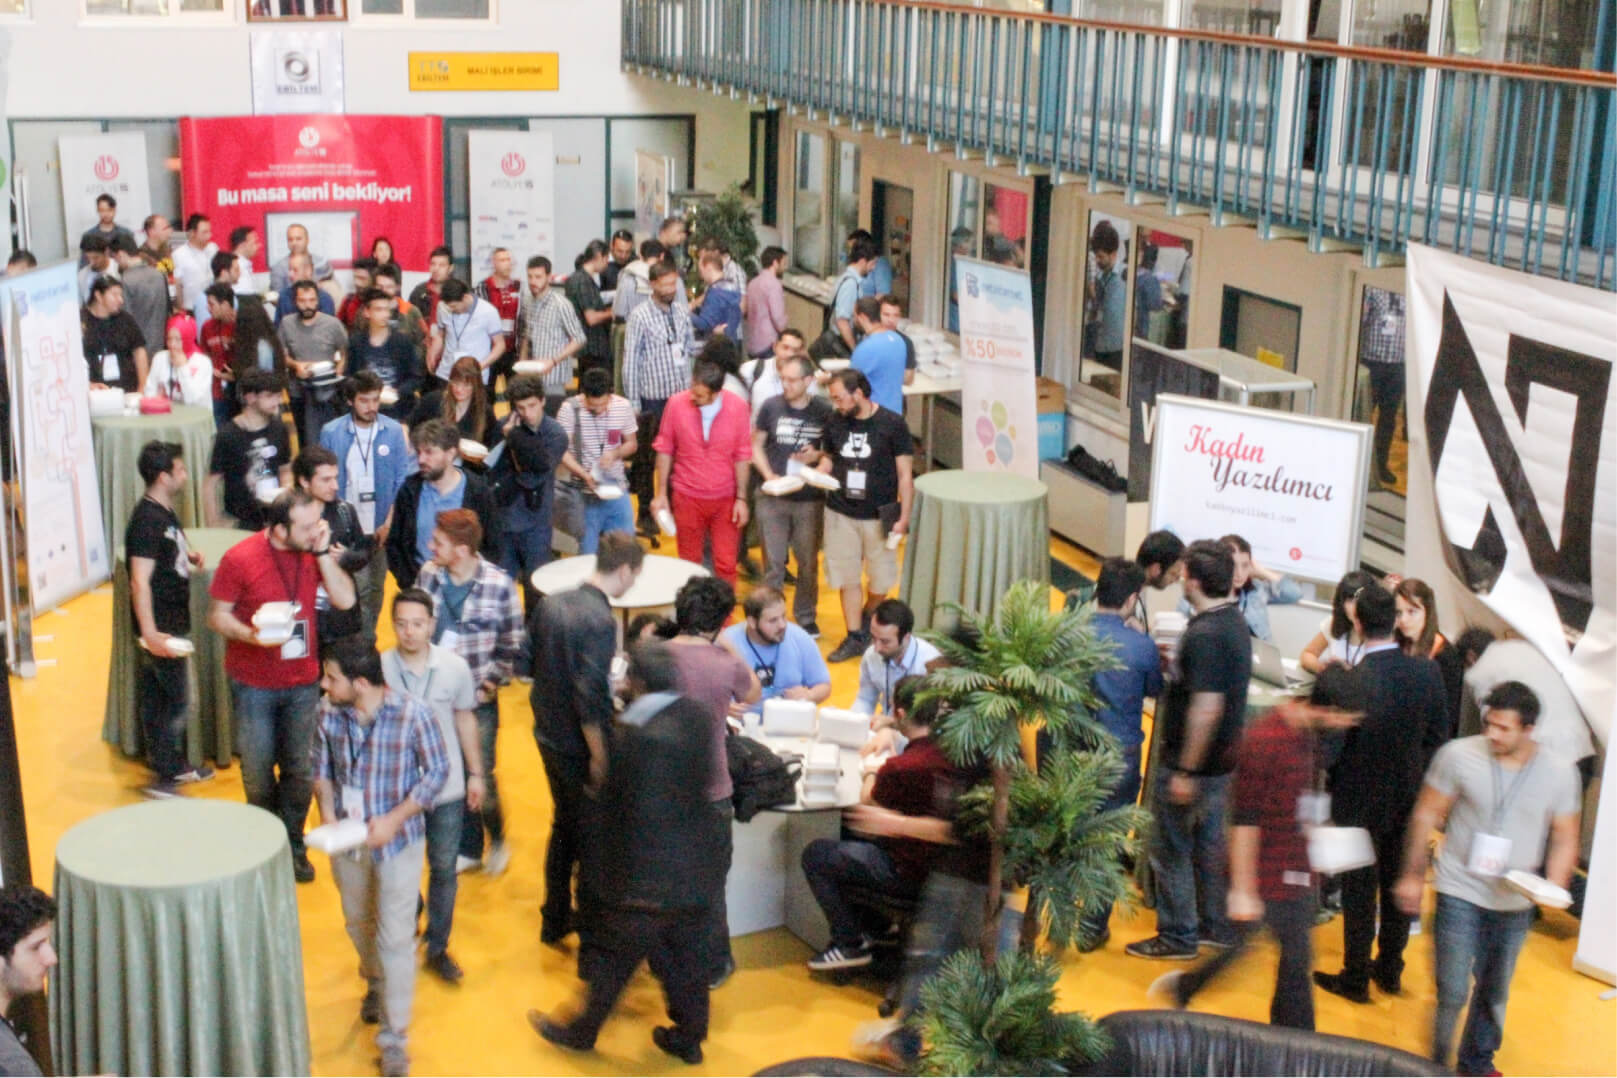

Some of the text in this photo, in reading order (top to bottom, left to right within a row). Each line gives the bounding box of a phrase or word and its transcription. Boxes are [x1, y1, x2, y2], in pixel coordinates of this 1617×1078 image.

[217, 182, 411, 206] Bu masa seni bekliyor!
[965, 335, 996, 360] %50
